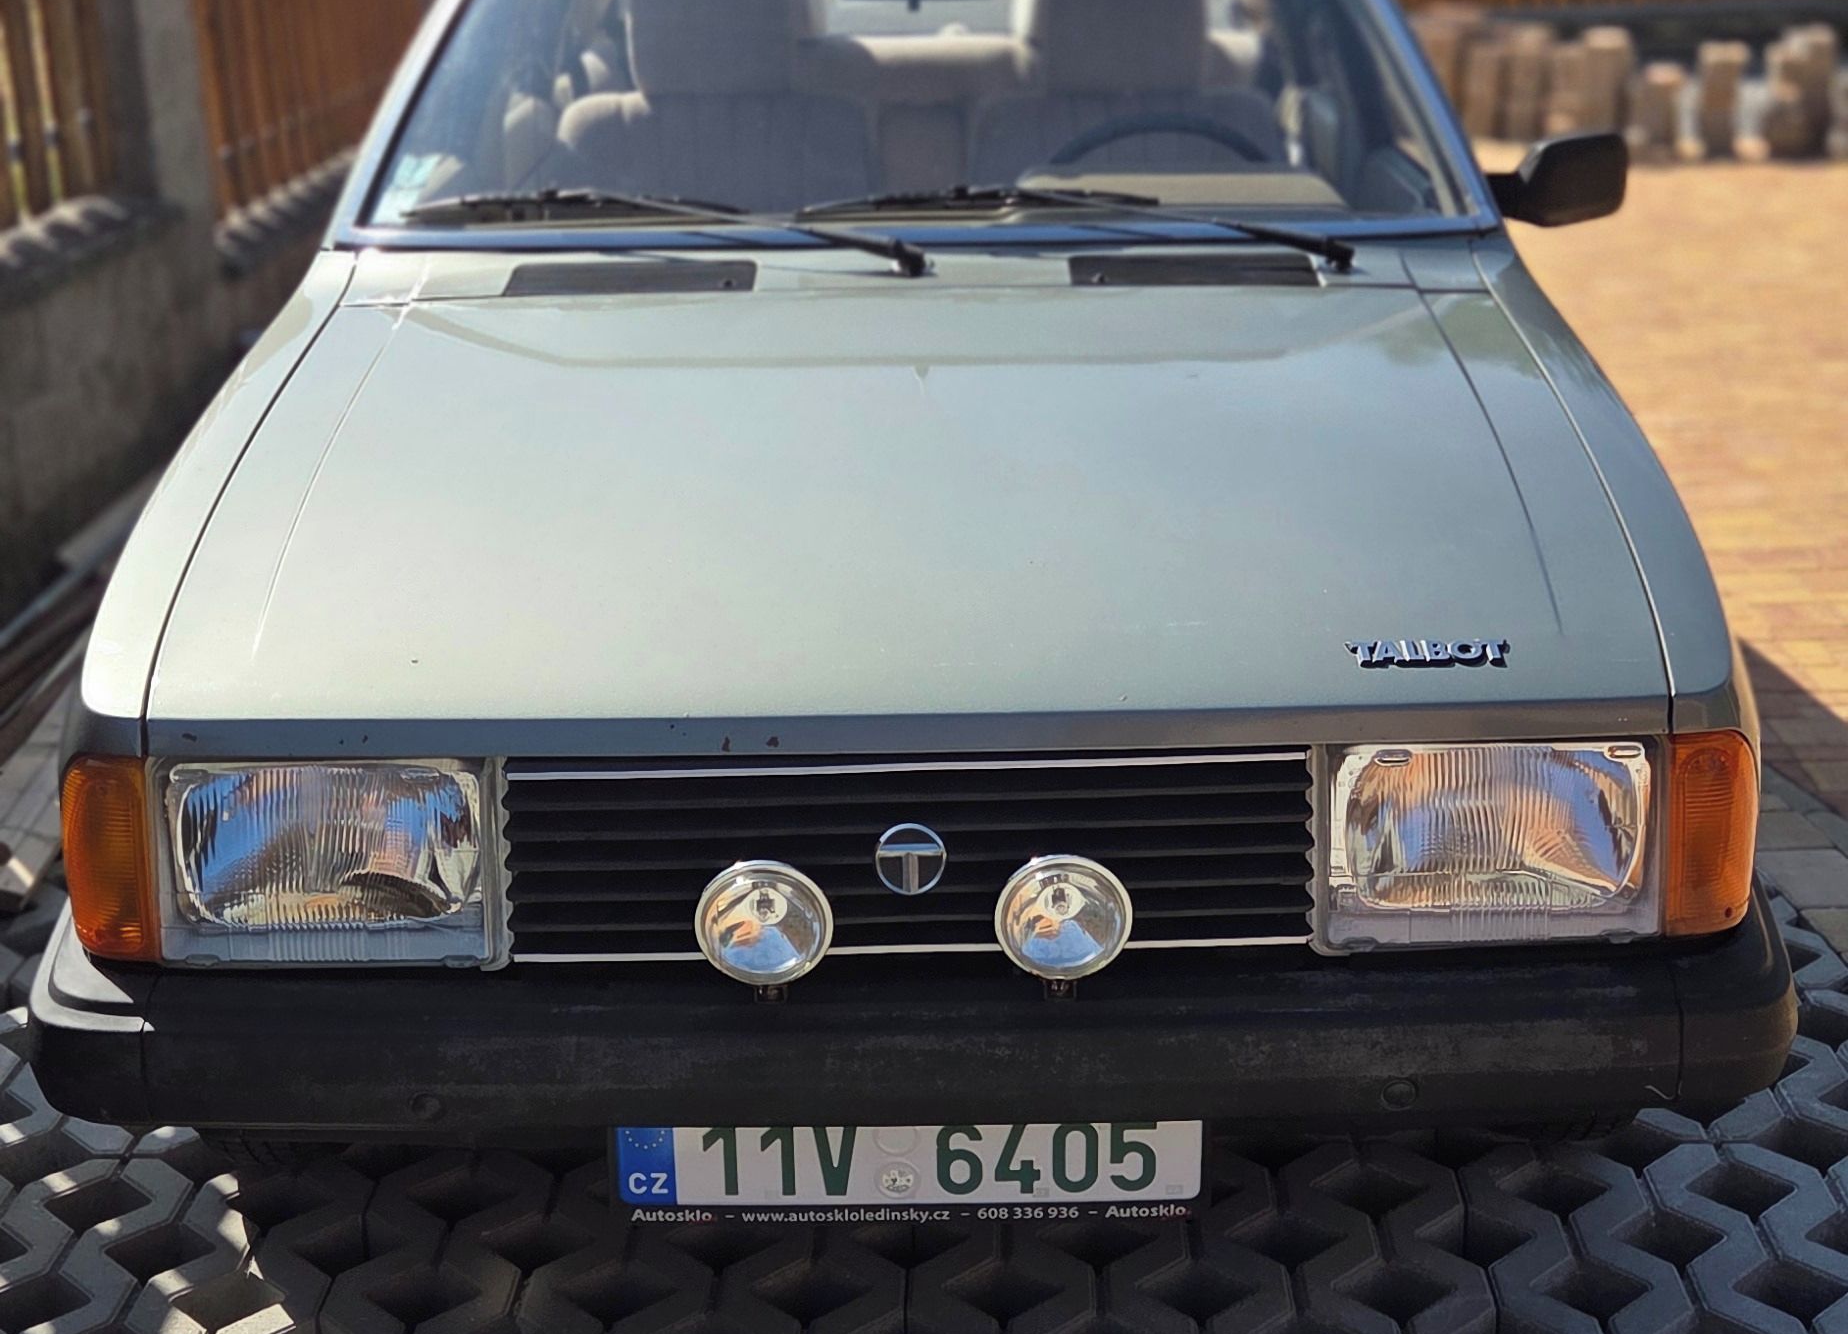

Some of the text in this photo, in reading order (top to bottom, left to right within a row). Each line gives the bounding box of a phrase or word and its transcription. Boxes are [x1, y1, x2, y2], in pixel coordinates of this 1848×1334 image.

[1345, 639, 1510, 668] TALBOT
[702, 1122, 1157, 1196] 11V 6405
[628, 1172, 669, 1194] CZ
[742, 1208, 950, 1224] www.autoskloledinsky.cz
[977, 1207, 1009, 1219] 608
[1013, 1207, 1043, 1219] 336
[1047, 1206, 1079, 1218] 936
